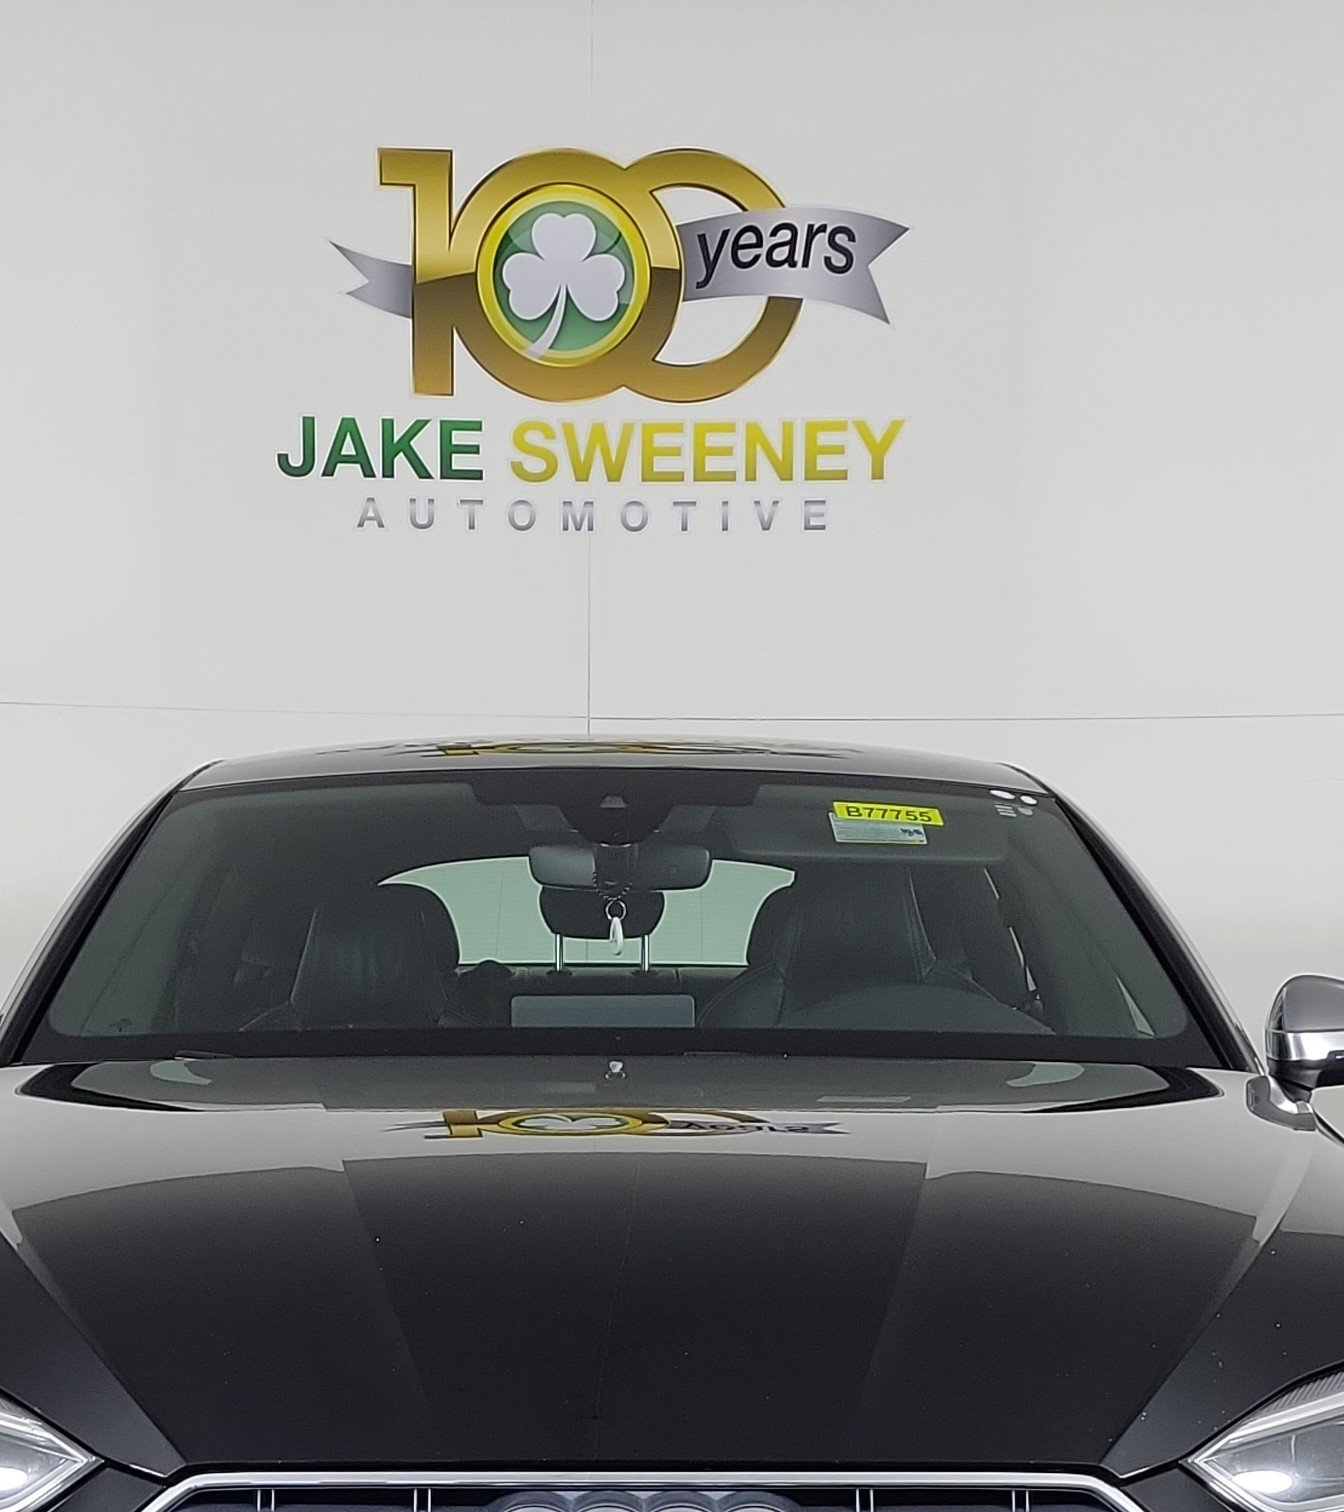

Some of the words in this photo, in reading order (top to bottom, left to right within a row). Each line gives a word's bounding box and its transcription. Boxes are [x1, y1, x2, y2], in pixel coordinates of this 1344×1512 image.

[694, 219, 857, 290] years
[276, 416, 485, 480] JAKE
[509, 419, 905, 483] SWEENEY
[357, 496, 828, 533] AUTOMOTIVE
[846, 805, 933, 823] B77755
